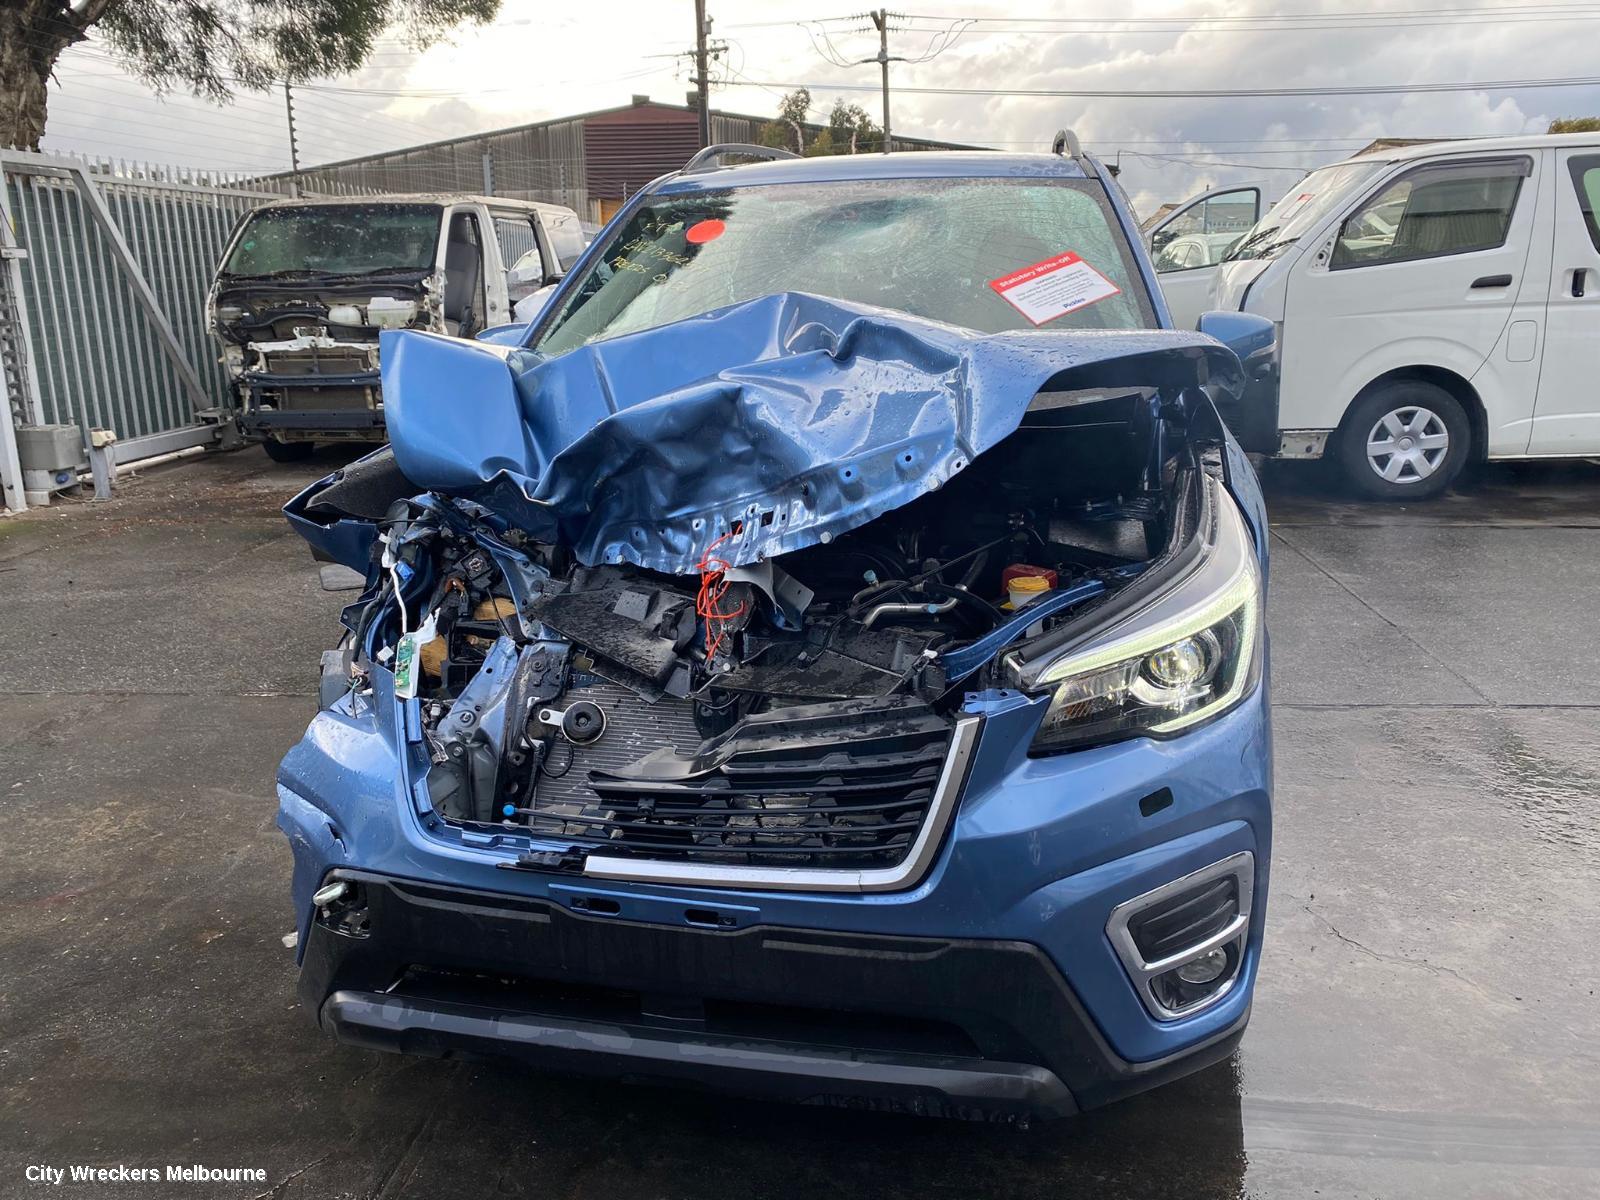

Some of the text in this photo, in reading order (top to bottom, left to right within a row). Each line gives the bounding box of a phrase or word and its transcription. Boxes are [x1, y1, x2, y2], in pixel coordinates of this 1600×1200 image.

[999, 269, 1036, 288] Statutory
[1035, 255, 1071, 273] Write-Off
[1063, 297, 1086, 309] Pickles
